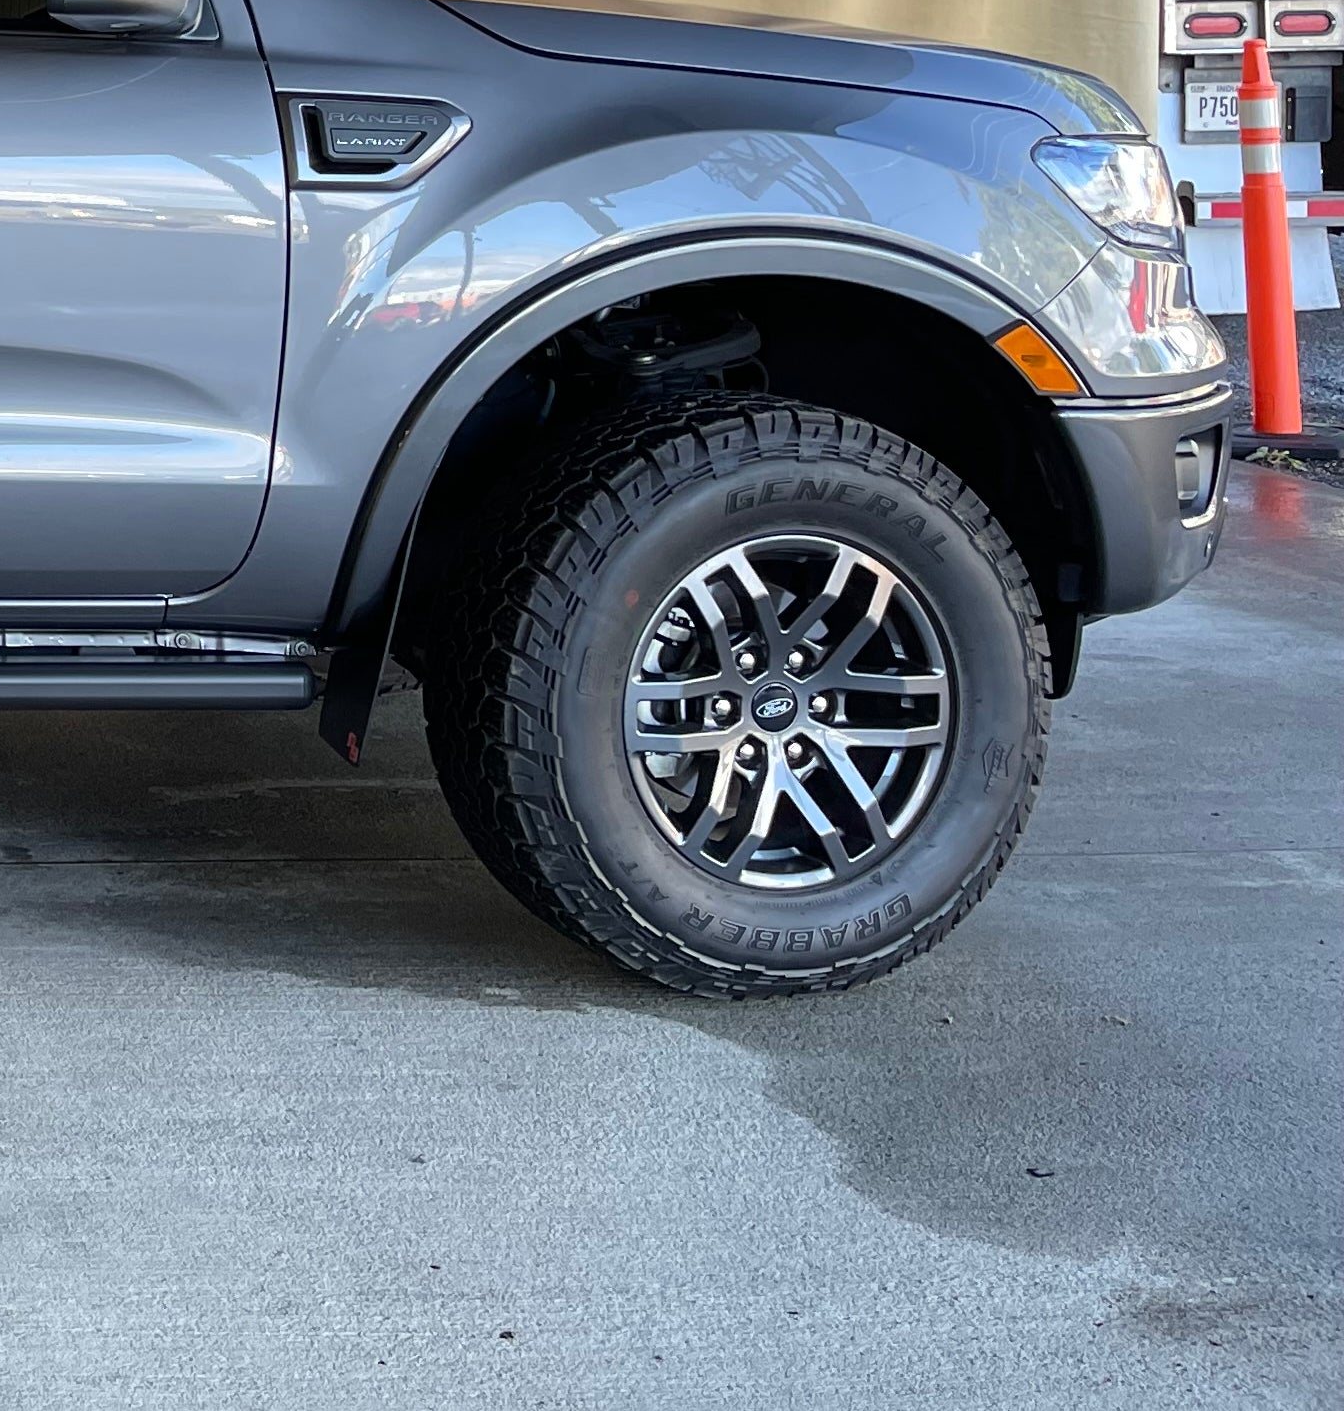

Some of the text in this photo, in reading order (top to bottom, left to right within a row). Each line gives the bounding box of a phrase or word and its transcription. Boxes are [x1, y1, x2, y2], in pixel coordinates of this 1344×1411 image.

[327, 111, 439, 126] RANGER
[335, 137, 407, 147] LARIAT
[724, 476, 949, 564] GENERAL
[678, 892, 914, 954] GRABBER
